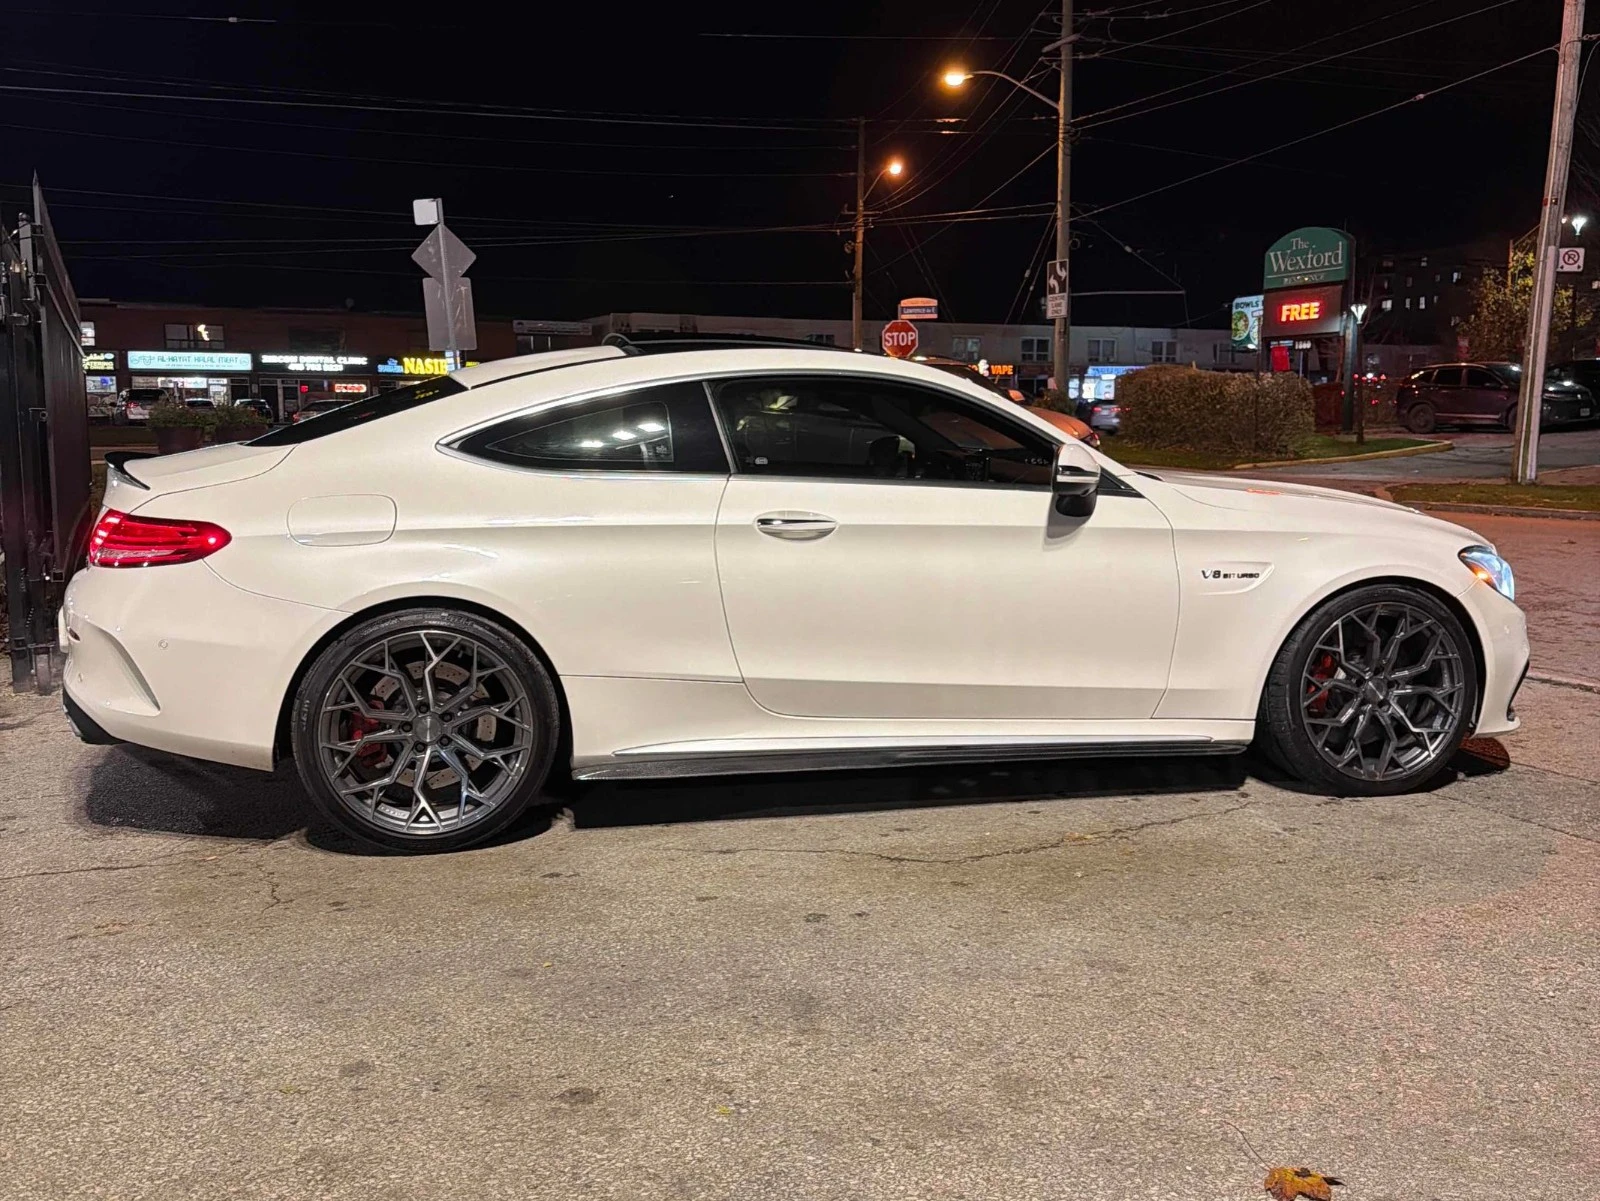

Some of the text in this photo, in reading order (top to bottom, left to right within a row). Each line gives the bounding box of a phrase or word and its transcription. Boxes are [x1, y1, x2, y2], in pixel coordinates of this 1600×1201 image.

[1290, 238, 1310, 250] The
[1269, 241, 1343, 273] Wexford
[1235, 300, 1260, 309] BOWLS
[1281, 302, 1320, 322] FREE
[884, 331, 916, 346] STOP
[194, 356, 215, 364] HALAL
[218, 356, 238, 364] MEAT
[990, 365, 1014, 375] VAPE
[1201, 569, 1222, 580] V8
